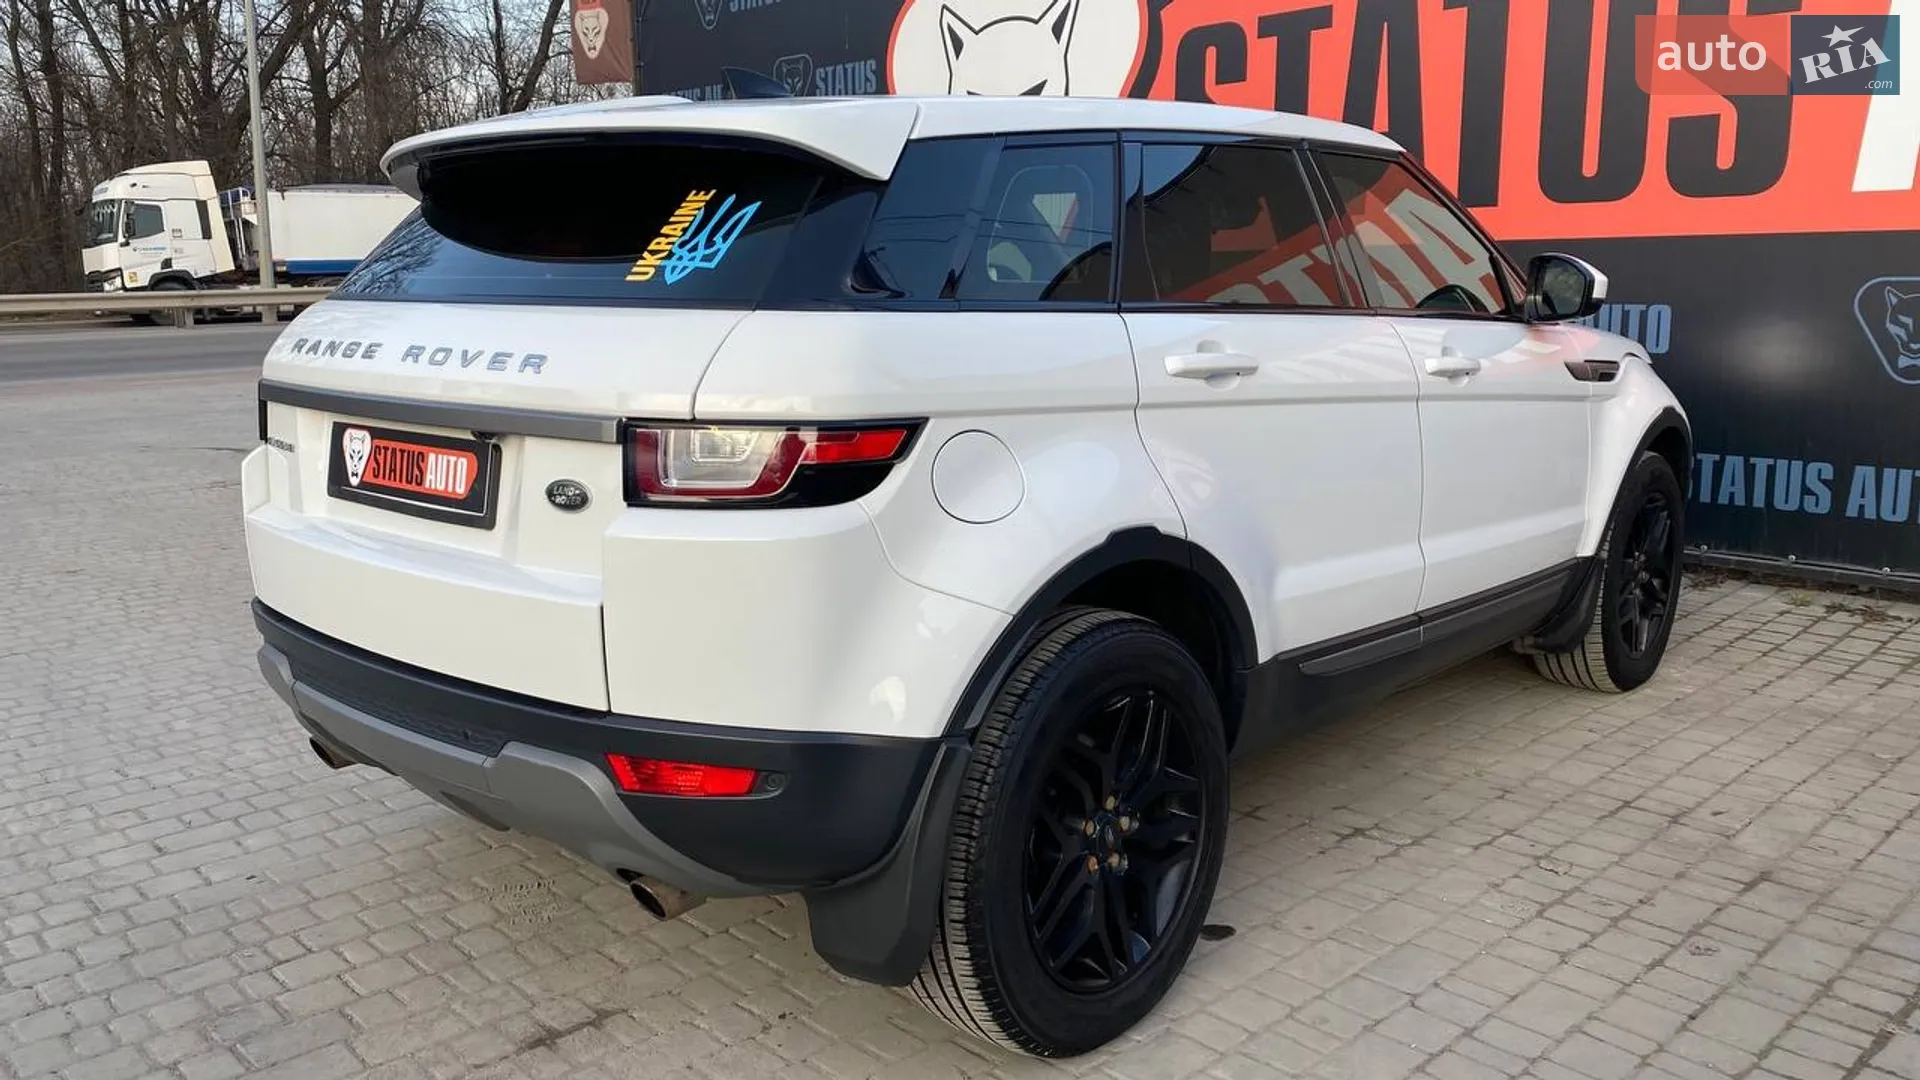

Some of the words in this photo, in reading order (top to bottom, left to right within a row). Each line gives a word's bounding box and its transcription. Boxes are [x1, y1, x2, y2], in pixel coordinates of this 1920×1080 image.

[815, 59, 877, 97] STATUS
[625, 189, 717, 282] UKRAINE
[1580, 304, 1672, 354] UTO
[290, 337, 384, 360] RANGE
[401, 345, 549, 374] ROVER
[1688, 452, 1834, 515] TATUS
[1845, 465, 1920, 523] AU
